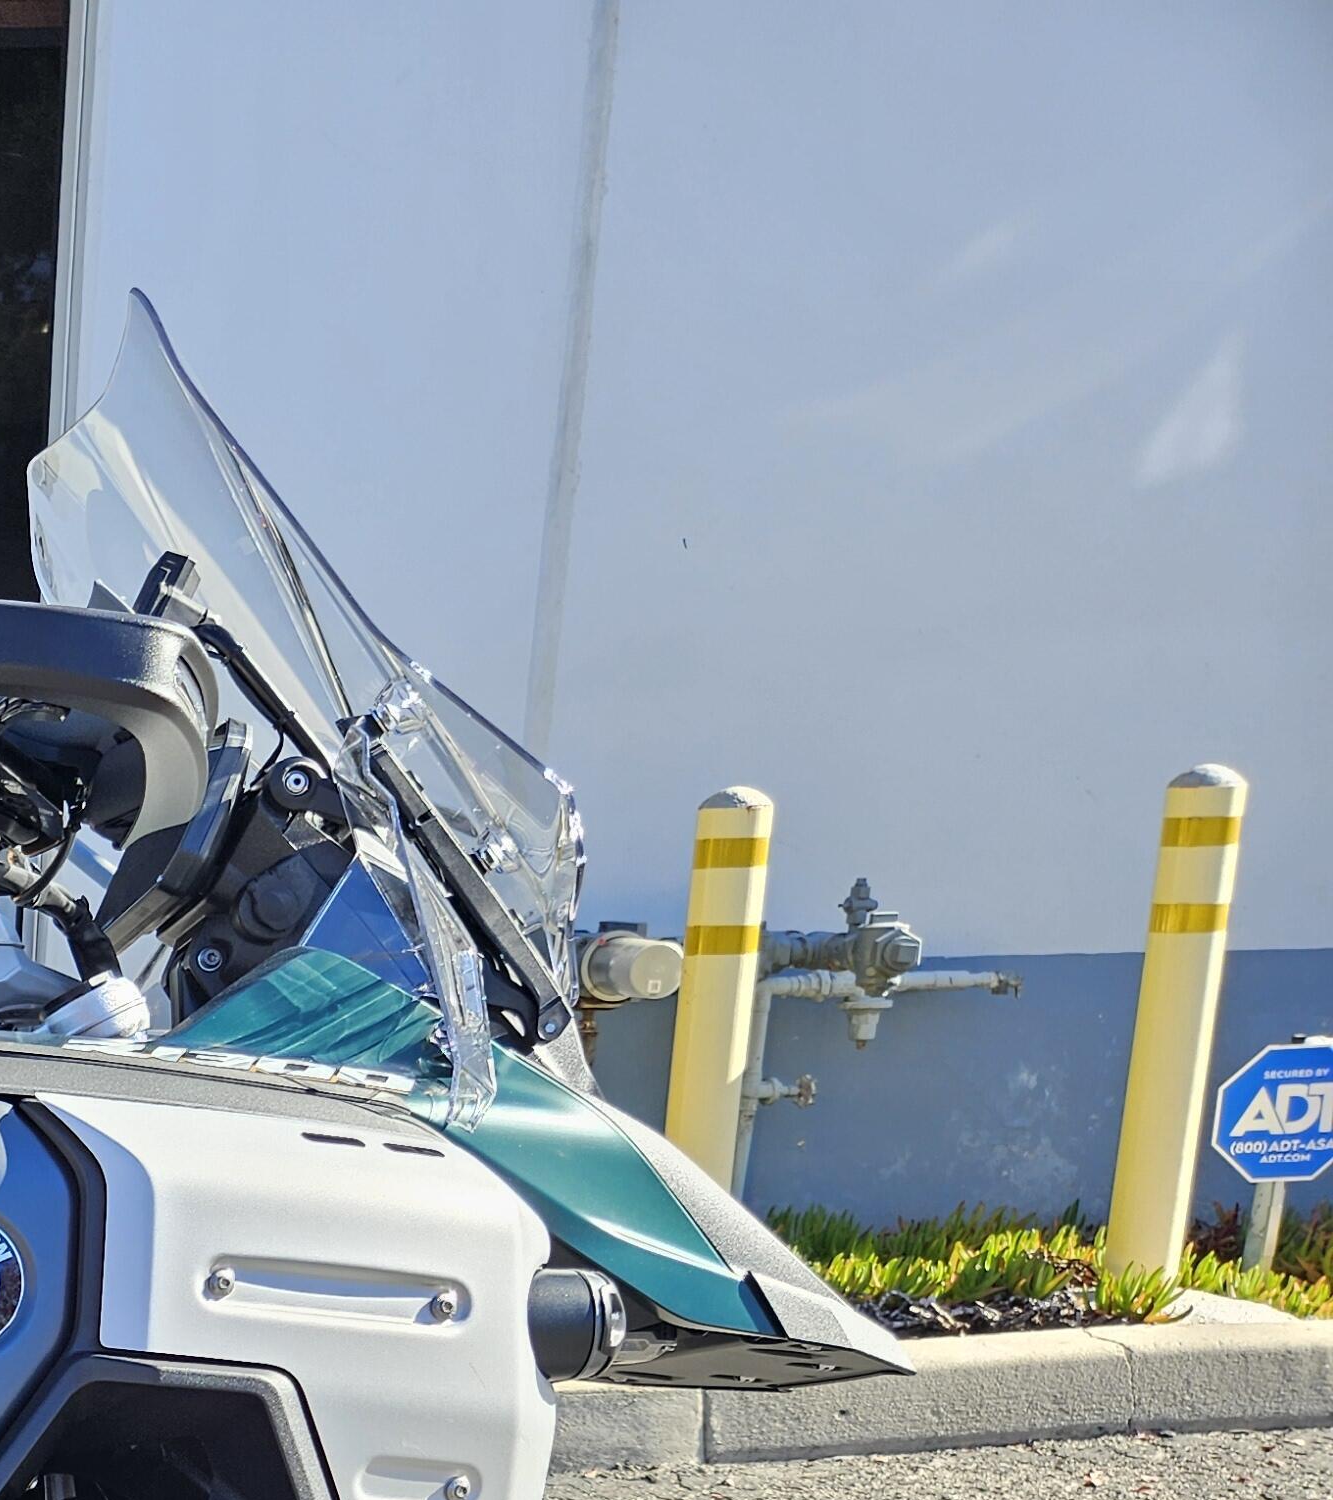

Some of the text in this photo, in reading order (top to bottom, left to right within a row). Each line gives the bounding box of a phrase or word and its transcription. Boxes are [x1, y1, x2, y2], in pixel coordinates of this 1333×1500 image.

[1263, 1067, 1331, 1080] SECURED BY
[1229, 1082, 1333, 1138] ADT
[1230, 1140, 1268, 1156] (800)
[1259, 1153, 1312, 1164] ADT.COM
